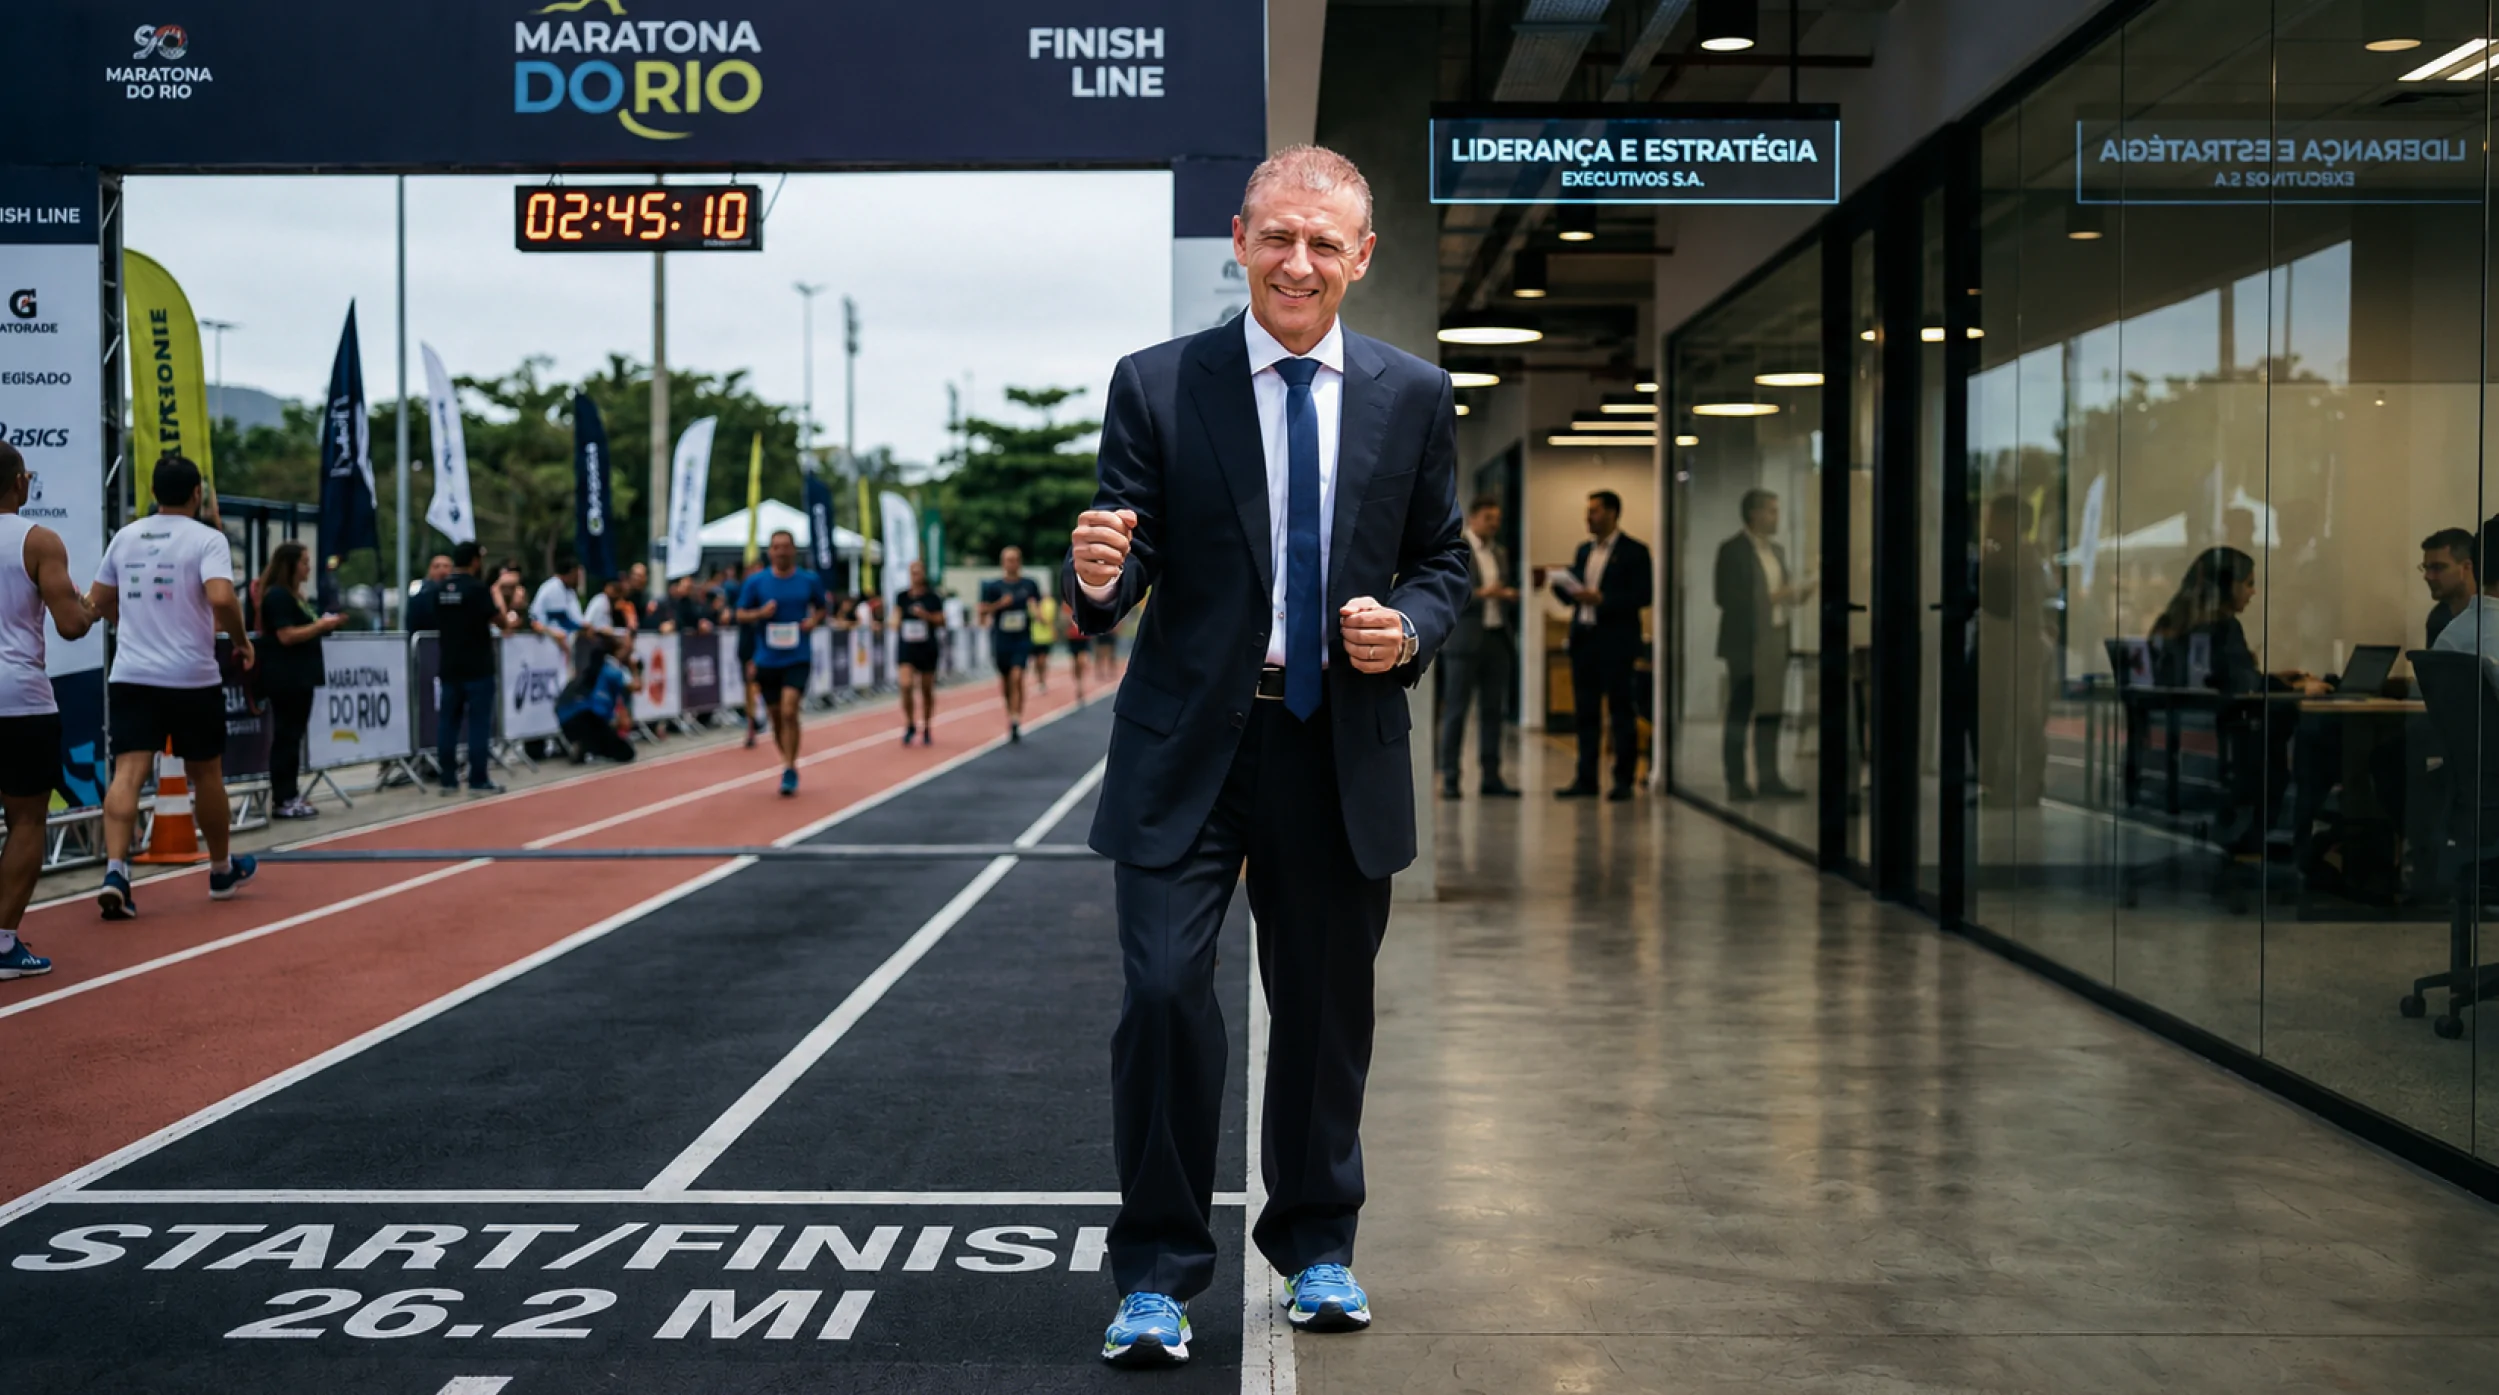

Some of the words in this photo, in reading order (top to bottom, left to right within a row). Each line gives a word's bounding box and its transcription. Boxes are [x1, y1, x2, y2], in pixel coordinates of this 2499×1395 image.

[514, 20, 762, 53] MARATONA
[1029, 27, 1164, 59] FINISH
[106, 67, 213, 82] MARATONA
[514, 60, 624, 114] DO
[634, 60, 763, 114] RIO
[1072, 66, 1165, 97] LINE
[126, 84, 155, 99] DO
[159, 84, 192, 99] RIO
[1452, 138, 1615, 167] LIDERANÇA
[1621, 138, 1638, 162] E
[1645, 133, 1818, 162] ESTRATÉGIA
[1561, 171, 1669, 187] EXECUTIVOS
[1672, 171, 1705, 187] S.A.
[36, 206, 81, 224] LINE
[9, 288, 37, 319] G
[329, 694, 354, 726] DO
[357, 692, 392, 730] RIO
[223, 1288, 617, 1339] 26.2
[653, 1290, 876, 1340] MI
